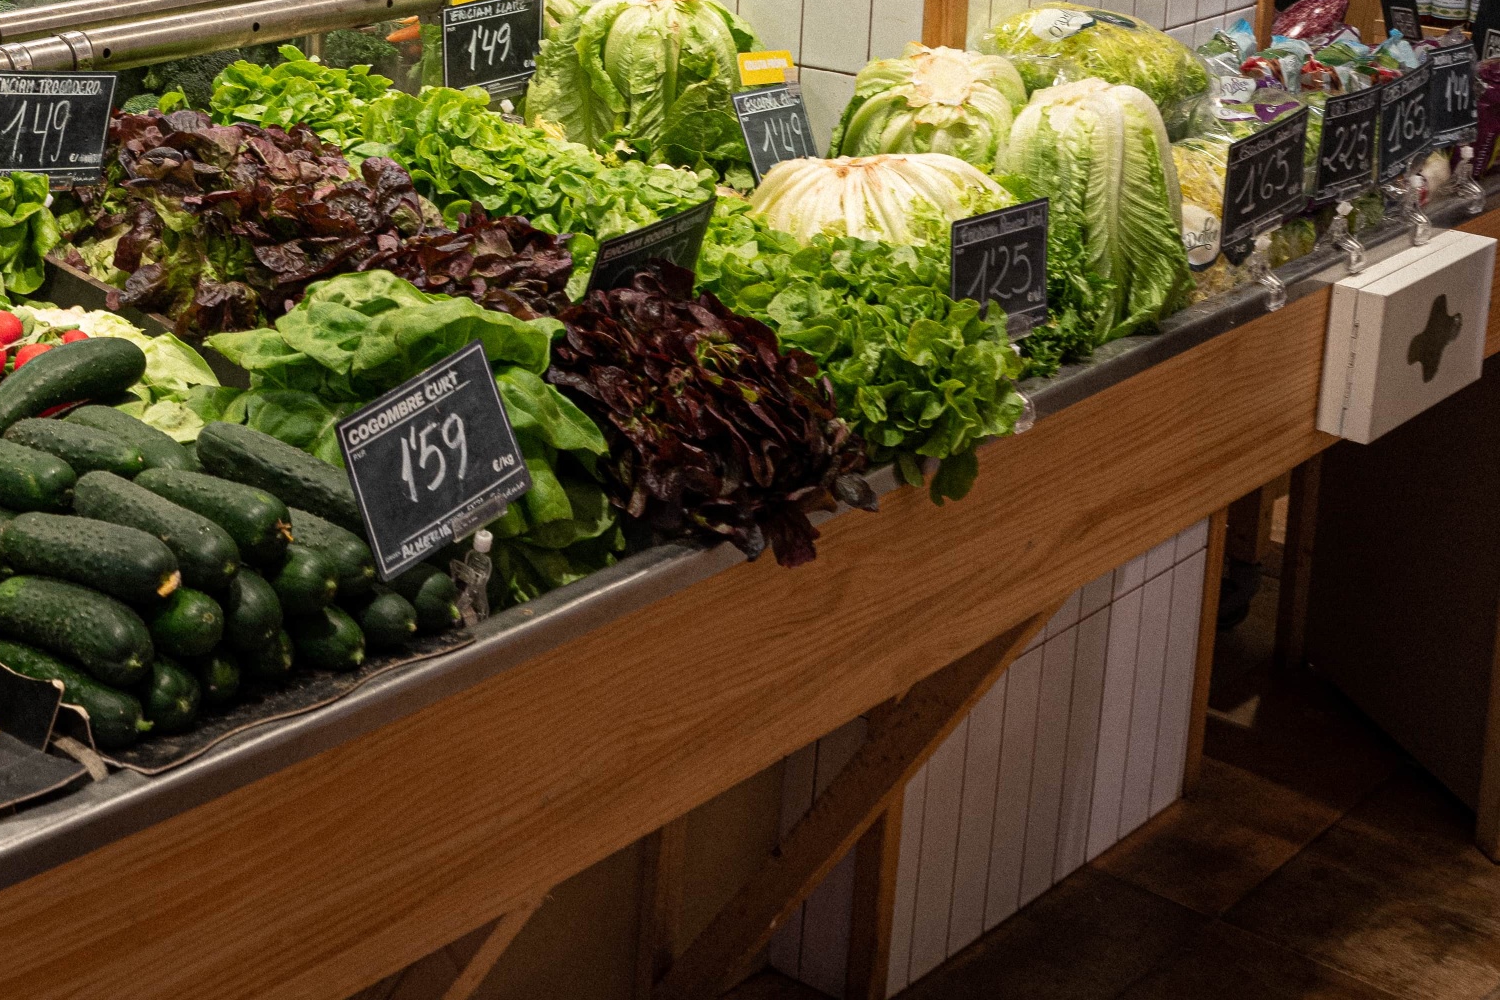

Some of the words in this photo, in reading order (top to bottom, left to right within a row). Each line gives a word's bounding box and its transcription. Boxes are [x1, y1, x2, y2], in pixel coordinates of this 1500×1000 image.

[468, 22, 511, 71] 1'49
[1235, 146, 1291, 215] 1'65
[967, 241, 1032, 308] 1'25
[348, 390, 426, 446] COGOMBRE
[424, 369, 459, 402] CURT
[400, 411, 469, 503] 1'59
[491, 453, 515, 473] €/kg
